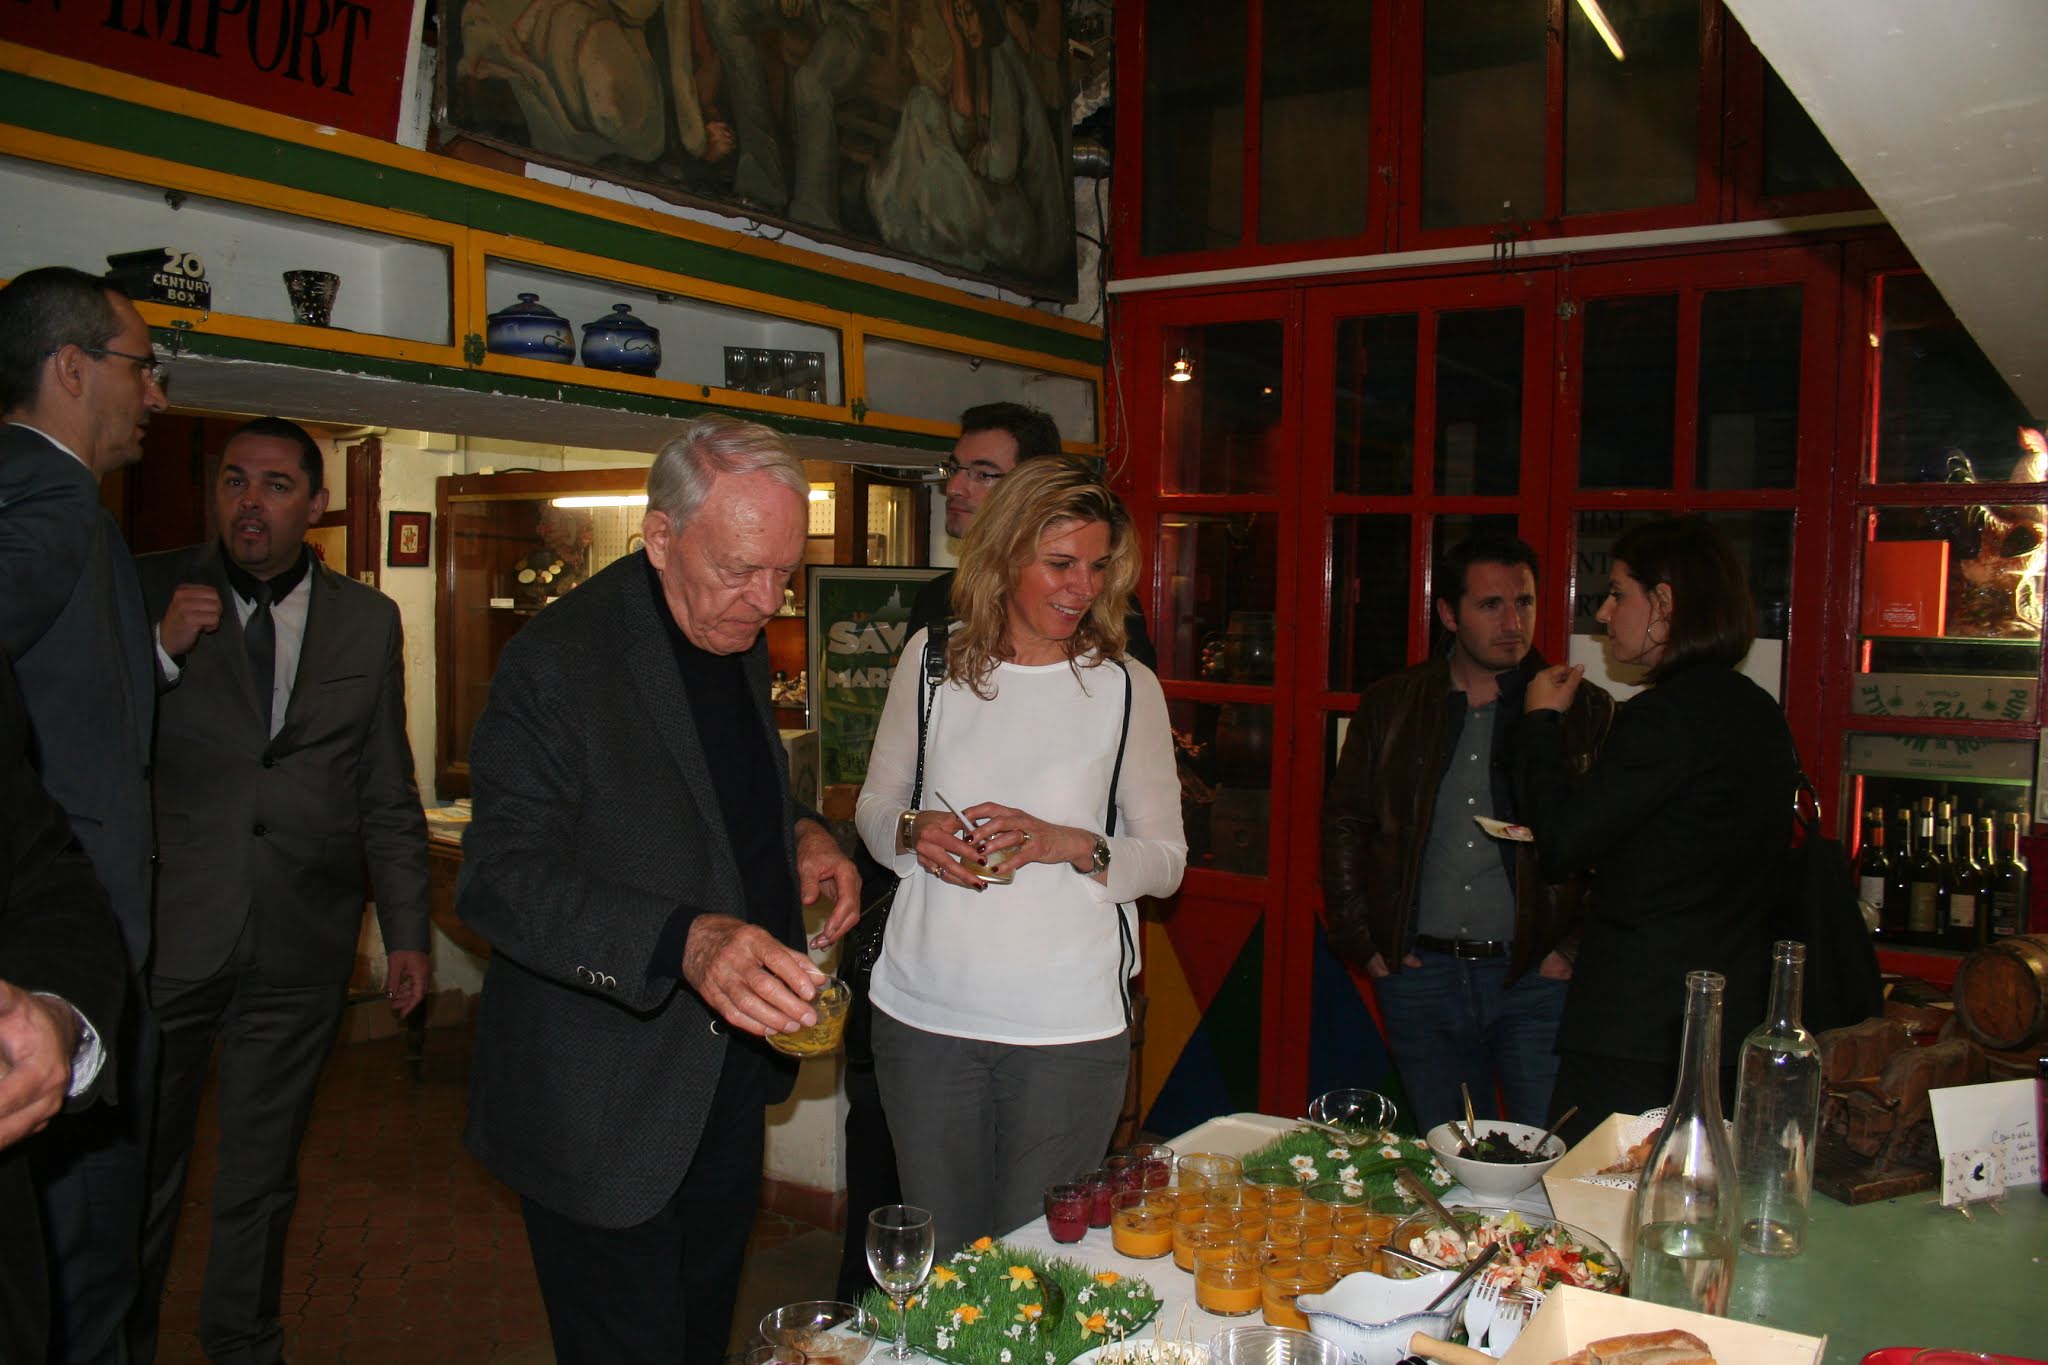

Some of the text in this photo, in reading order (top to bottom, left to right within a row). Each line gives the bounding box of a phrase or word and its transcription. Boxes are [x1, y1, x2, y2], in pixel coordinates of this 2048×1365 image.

[163, 247, 205, 279] 20
[153, 273, 211, 294] CENTURY
[167, 288, 196, 303] BOX
[828, 621, 908, 654] SAV
